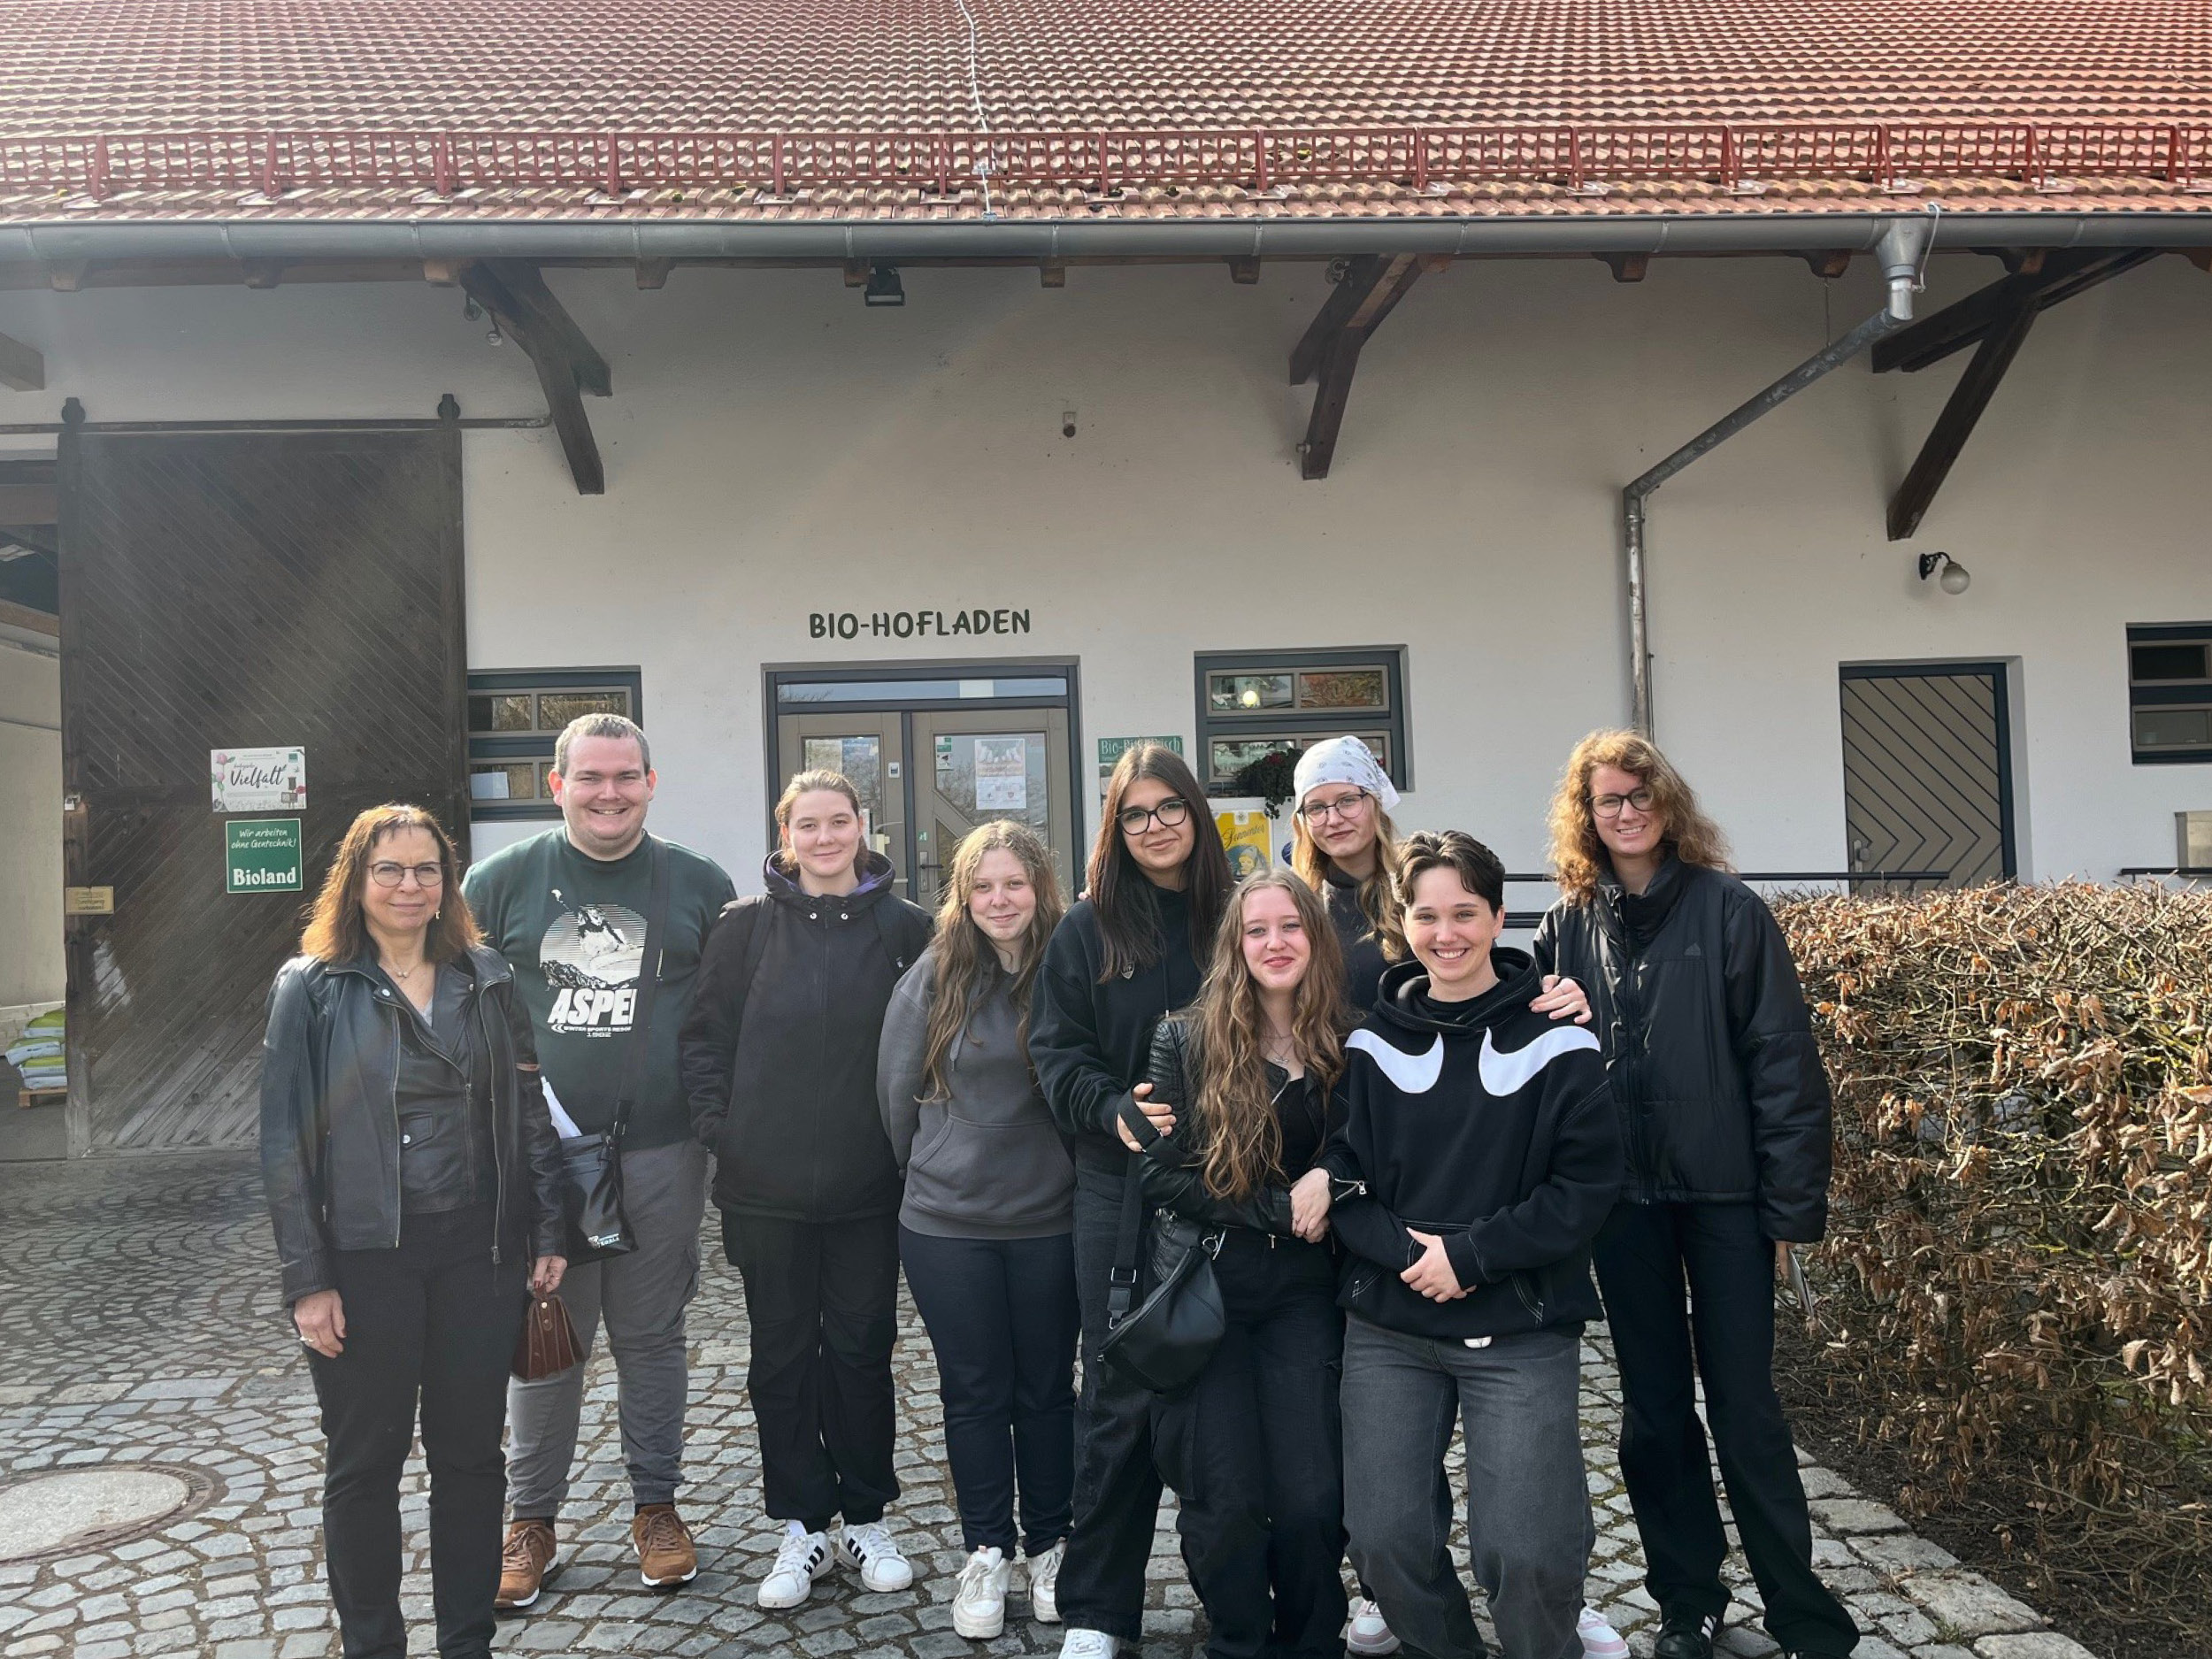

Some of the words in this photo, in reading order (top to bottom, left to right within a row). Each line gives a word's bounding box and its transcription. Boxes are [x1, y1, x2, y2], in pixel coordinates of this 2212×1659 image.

[809, 609, 1031, 640] BIO-HOFLADEN
[231, 764, 287, 789] Vielfalt
[231, 840, 250, 849] ohne
[250, 838, 296, 849] Gentechnik!
[239, 828, 254, 838] Wir
[255, 827, 288, 838] arbeiten
[233, 867, 296, 886] Bioland
[547, 987, 637, 1025] ASPE
